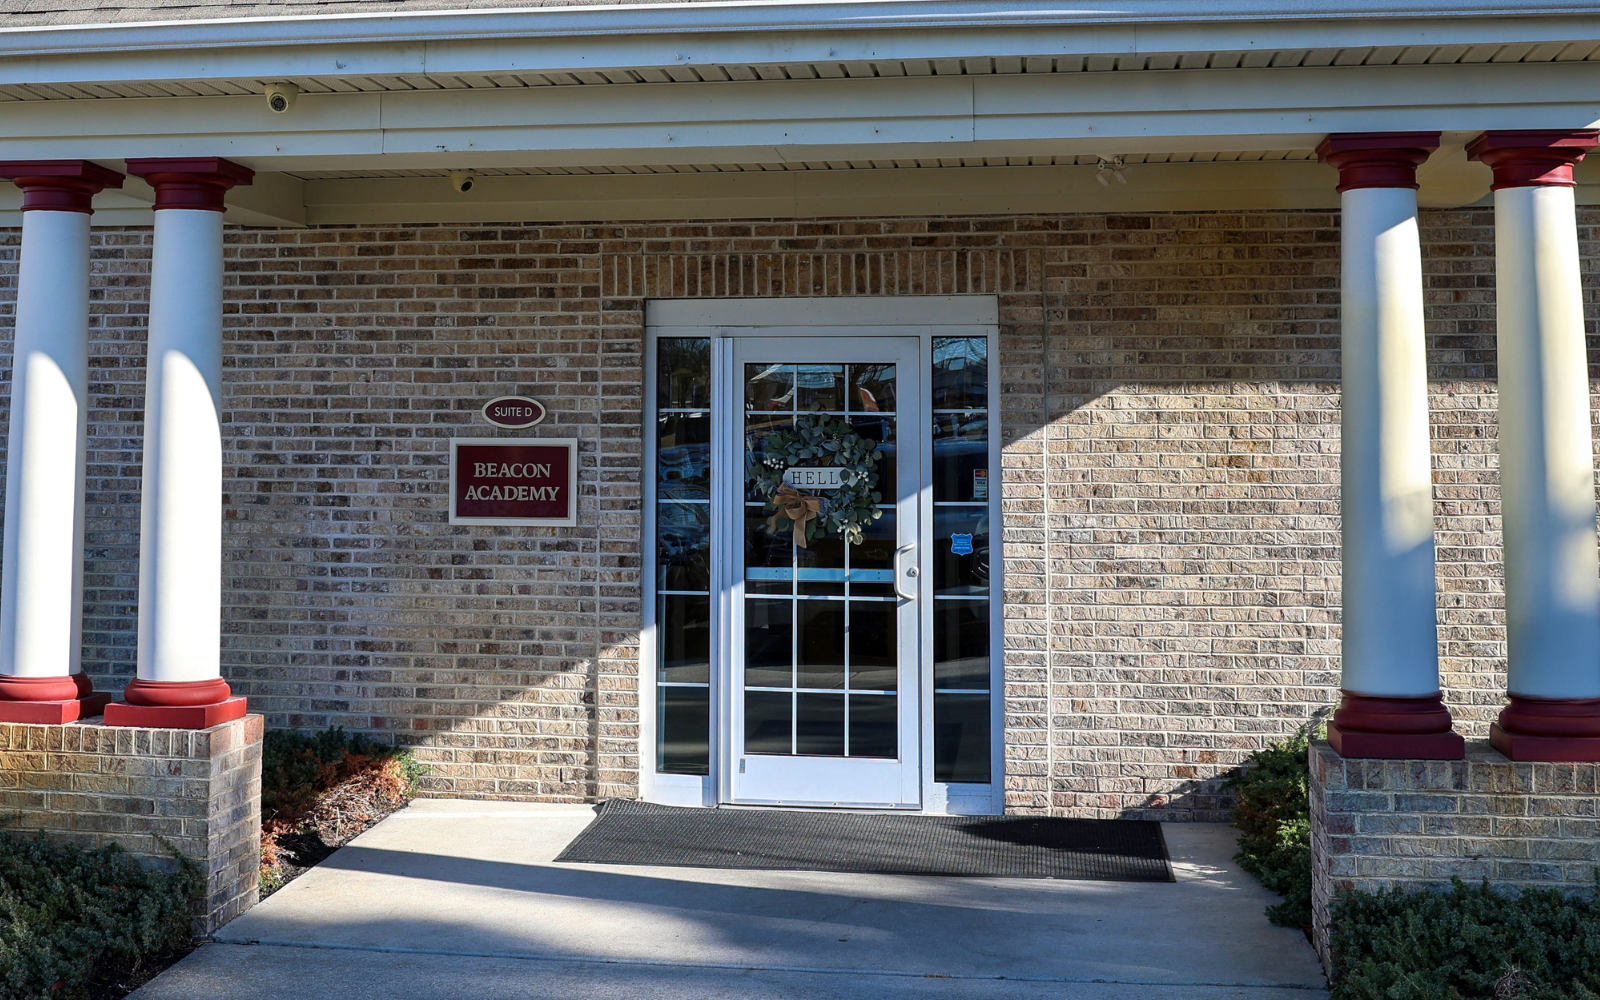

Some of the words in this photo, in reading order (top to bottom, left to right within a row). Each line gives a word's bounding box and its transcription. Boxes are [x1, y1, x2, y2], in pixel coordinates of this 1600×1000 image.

[494, 406, 522, 417] SUITE
[525, 407, 533, 417] D
[473, 462, 552, 478] BEACON
[464, 485, 560, 501] ACADEMY
